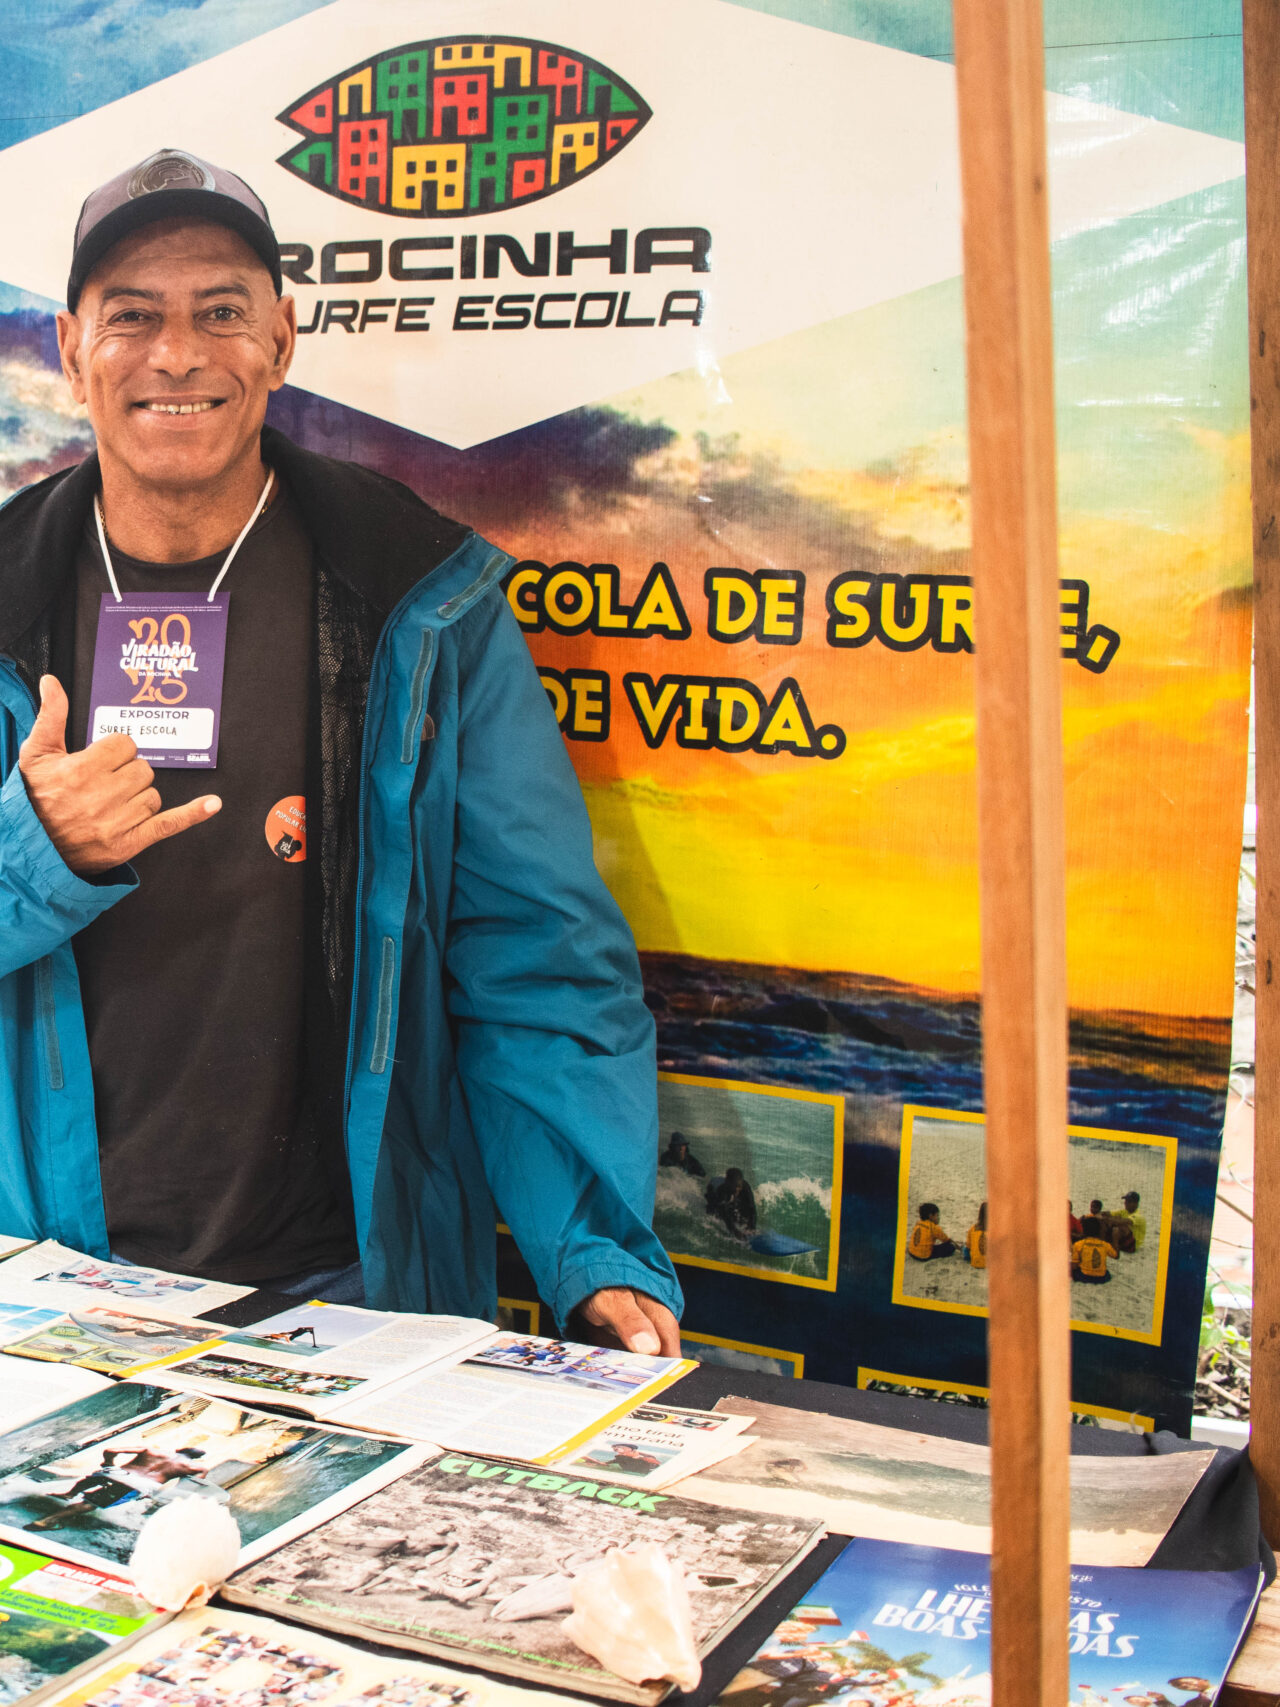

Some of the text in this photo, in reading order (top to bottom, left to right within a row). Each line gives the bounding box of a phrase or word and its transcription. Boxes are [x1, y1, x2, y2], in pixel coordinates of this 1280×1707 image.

[277, 227, 712, 285] ROCINHA
[453, 289, 704, 332] ESCOLA
[709, 569, 803, 641] DE
[830, 574, 1118, 668] SURE,
[120, 652, 199, 678] CULTURAL
[121, 638, 192, 658] VIRADÃO
[100, 725, 177, 736] SURFE ESCOLA
[120, 710, 189, 719] EXPOSITOR
[627, 676, 843, 755] VIDA.
[915, 1588, 992, 1622] LHE
